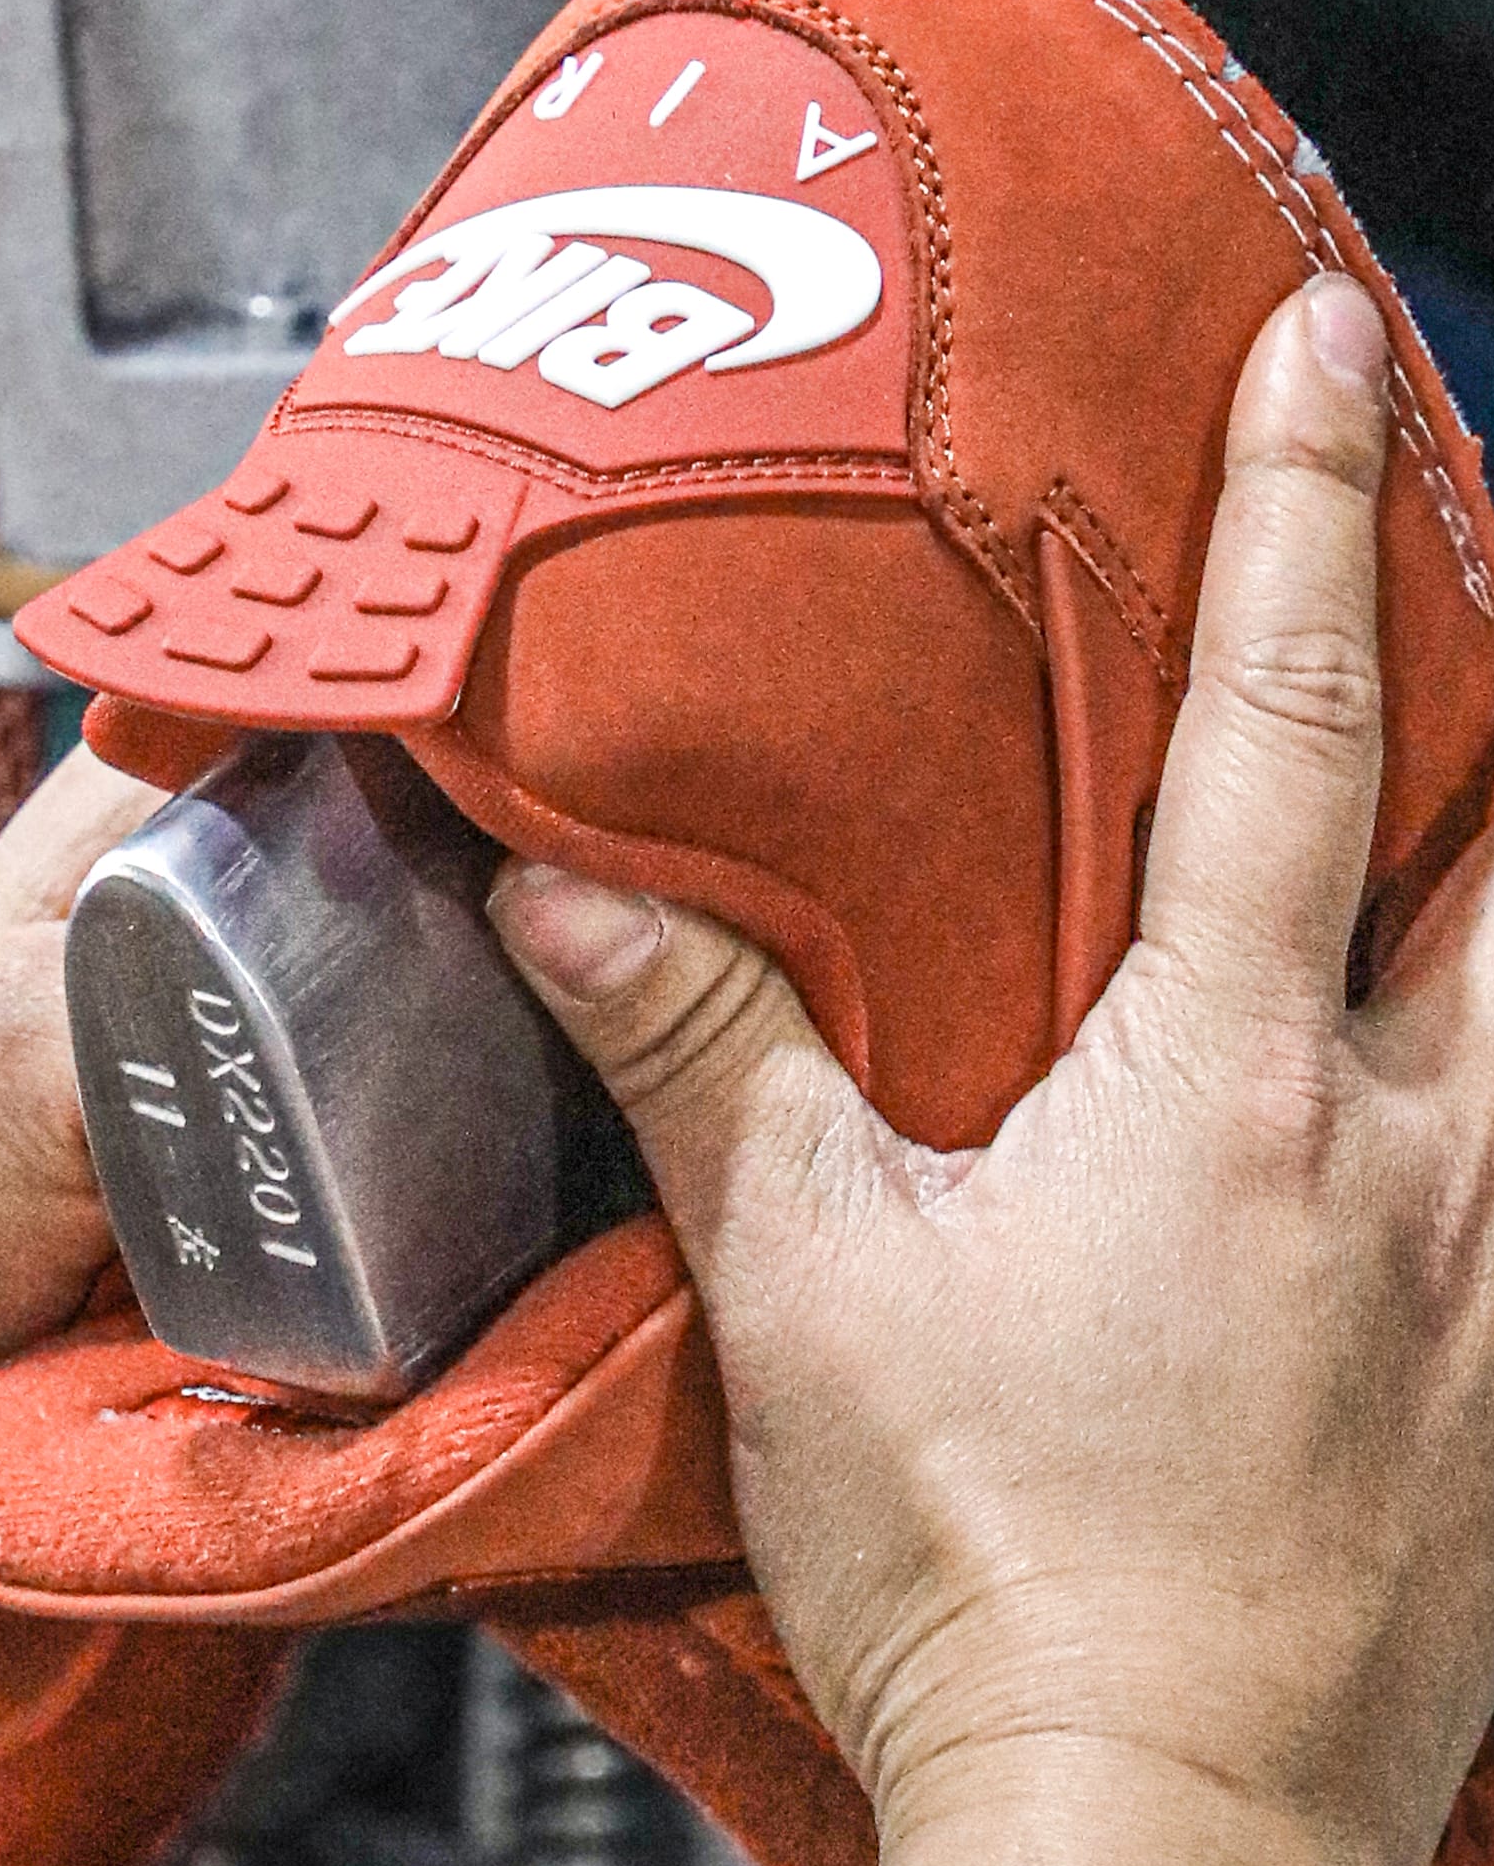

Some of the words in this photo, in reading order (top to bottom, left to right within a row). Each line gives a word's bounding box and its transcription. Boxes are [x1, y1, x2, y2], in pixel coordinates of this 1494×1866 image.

[533, 50, 879, 181] AIR
[118, 1059, 187, 1128] 11
[190, 988, 318, 1267] DX2201
